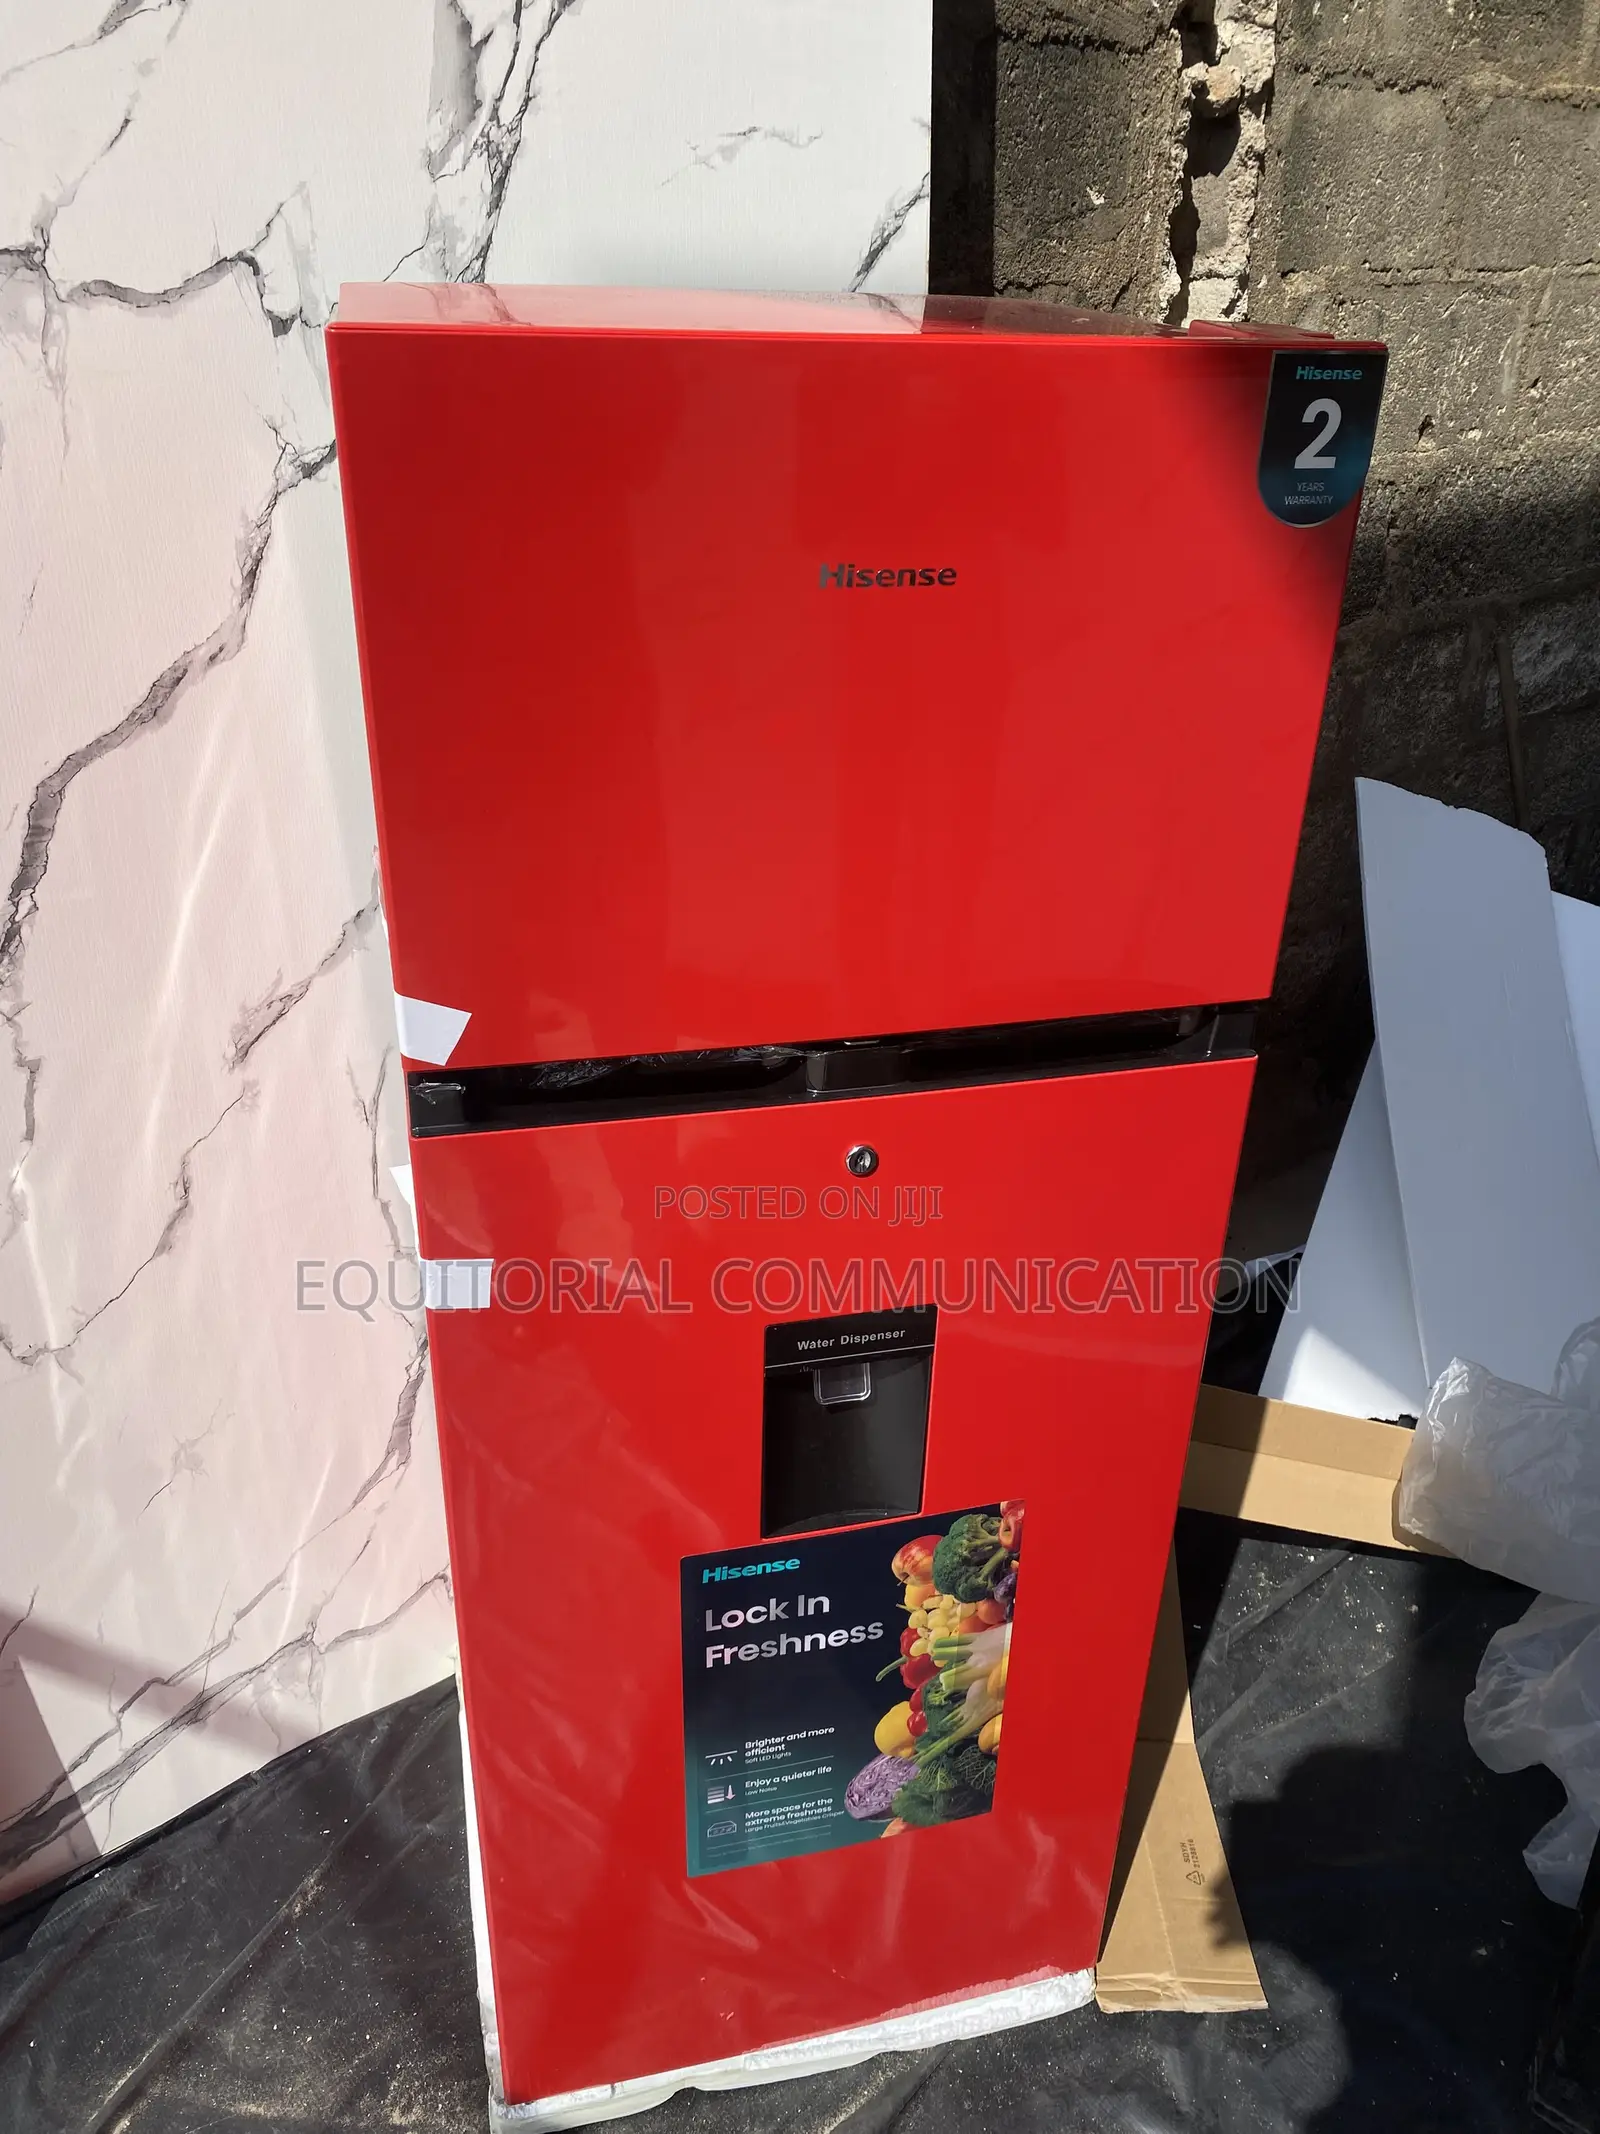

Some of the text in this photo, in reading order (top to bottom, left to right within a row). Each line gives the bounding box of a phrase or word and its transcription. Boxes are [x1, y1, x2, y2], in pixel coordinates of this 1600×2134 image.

[1296, 366, 1363, 380] Hisense
[1294, 398, 1342, 469] 2
[1297, 482, 1325, 492] YEARS
[1284, 495, 1334, 505] WARRANTY
[819, 562, 957, 588] Hisense
[797, 1329, 906, 1351] Water Dispenser
[702, 1557, 801, 1584] Hisense
[705, 1594, 830, 1633] Lock In
[705, 1621, 884, 1668] Freshness
[745, 1726, 835, 1749] Brighter and more
[745, 1743, 786, 1757] efficient
[772, 1751, 792, 1759] Lights
[745, 1777, 771, 1788] Enjoy
[781, 1769, 816, 1782] quieter
[817, 1765, 832, 1775] life
[745, 1797, 833, 1819] More space for the
[745, 1806, 832, 1827] extreme freshness
